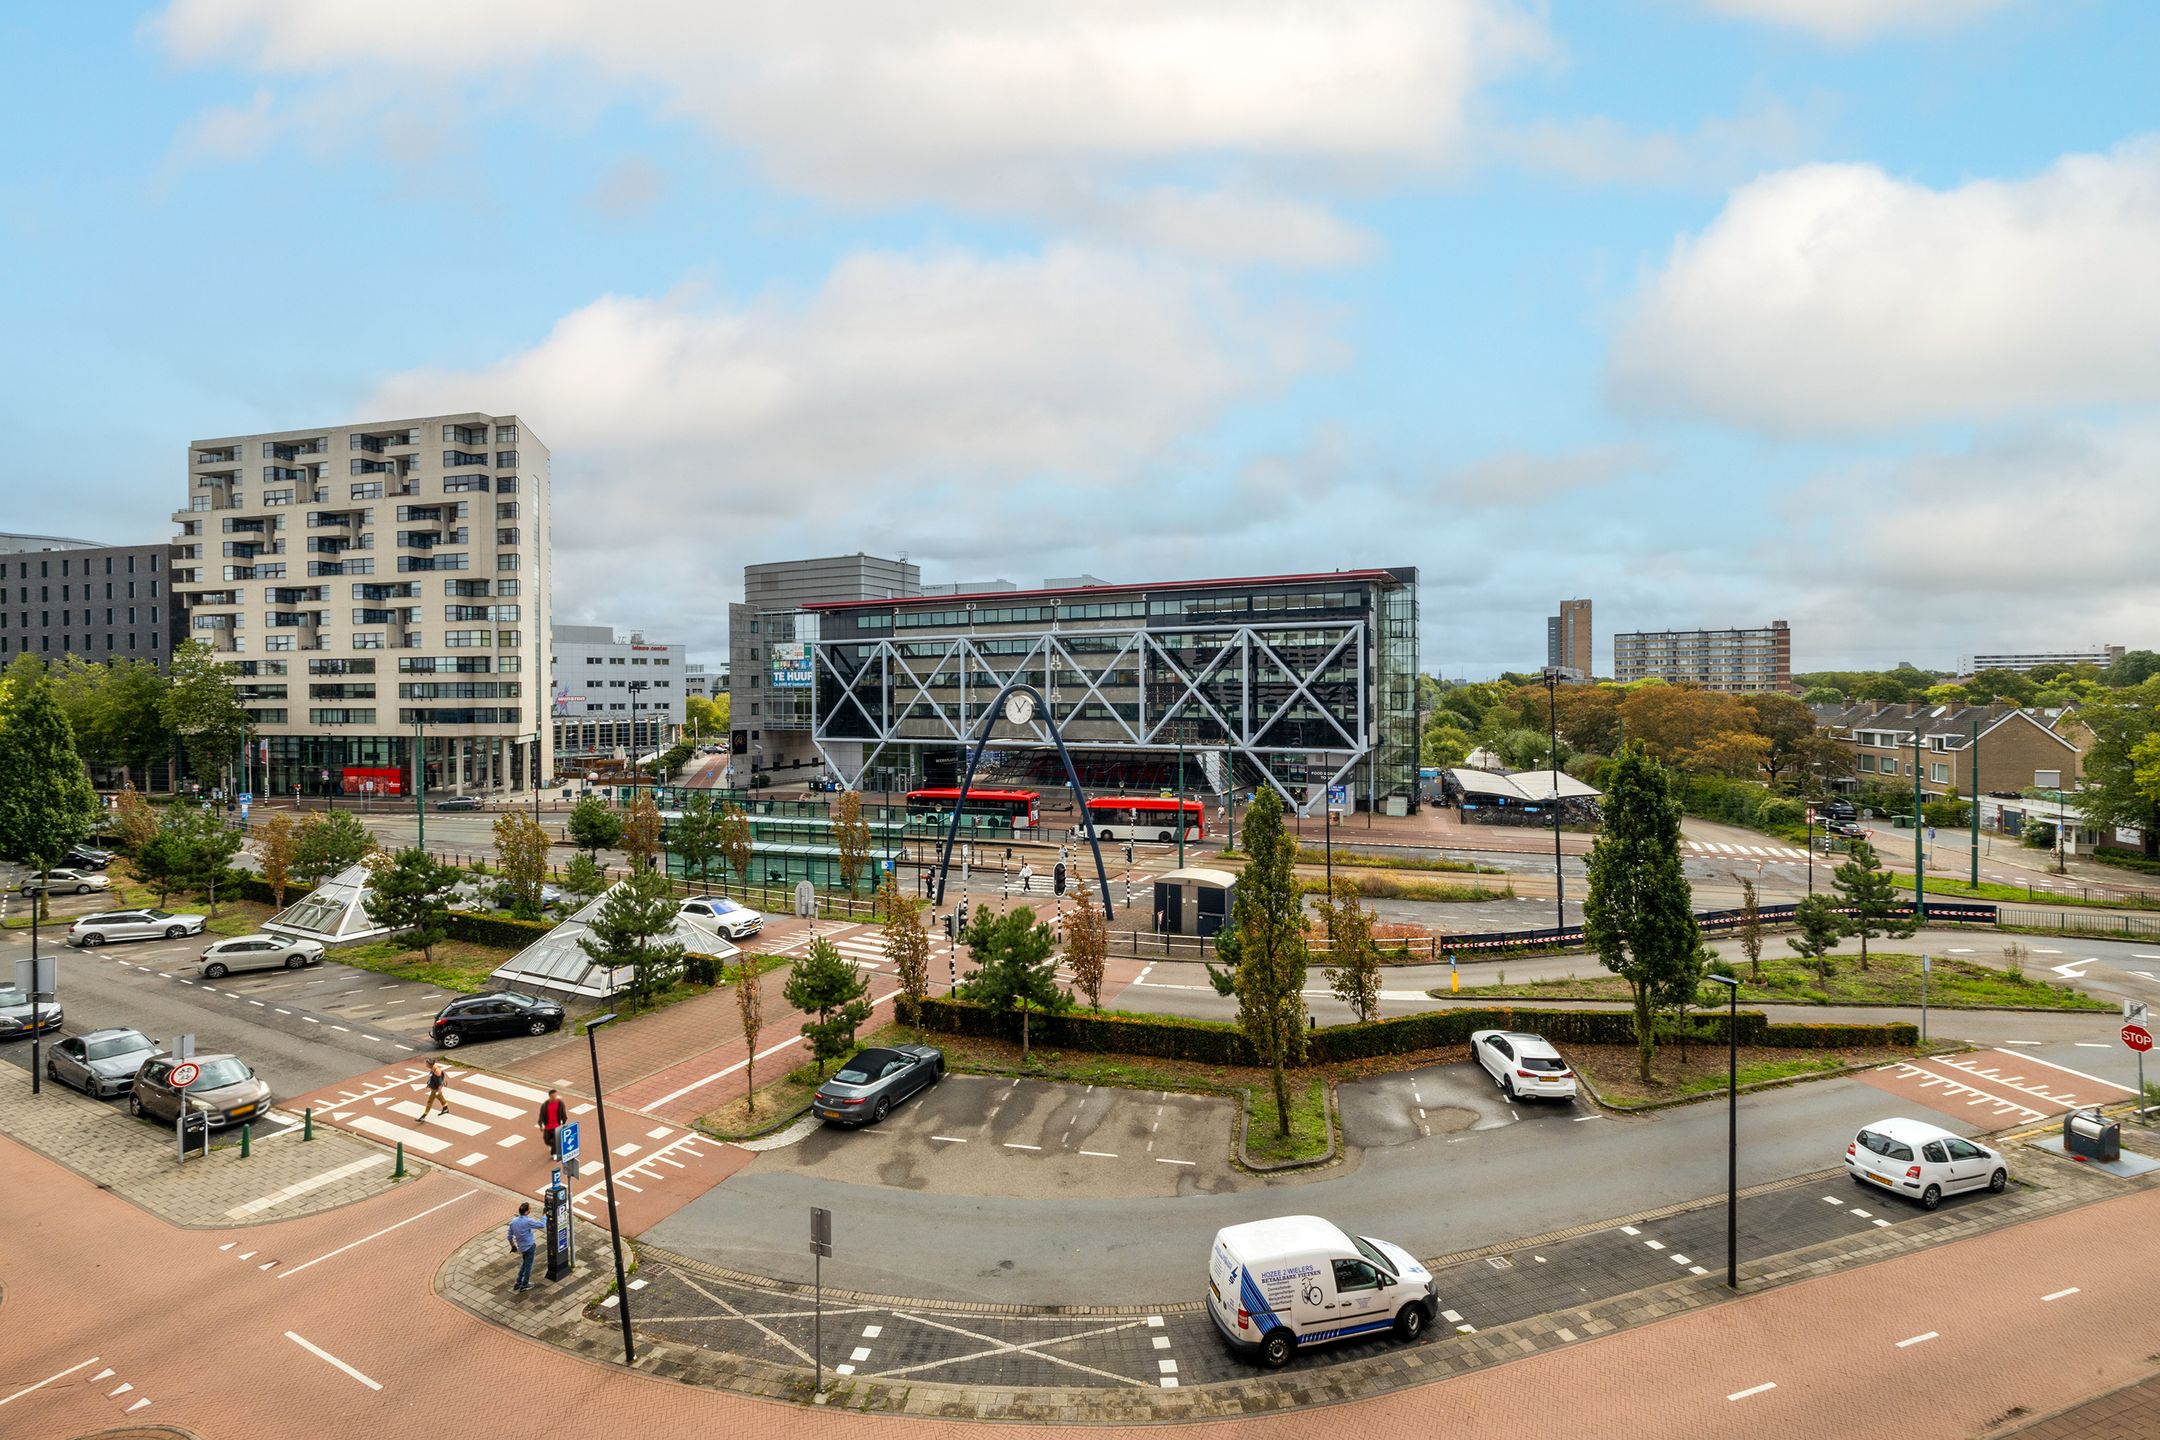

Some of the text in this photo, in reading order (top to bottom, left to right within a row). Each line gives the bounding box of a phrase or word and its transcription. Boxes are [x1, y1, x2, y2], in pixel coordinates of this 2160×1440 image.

[773, 671, 785, 681] TE
[2122, 1030, 2152, 1045] STOP
[563, 1128, 572, 1142] P
[554, 1172, 561, 1182] P
[559, 1190, 565, 1200] P
[560, 1205, 566, 1217] P
[1261, 1270, 1281, 1278] HOZEE
[1287, 1265, 1314, 1274] WIELERS
[1298, 1270, 1321, 1278] FIETSEN
